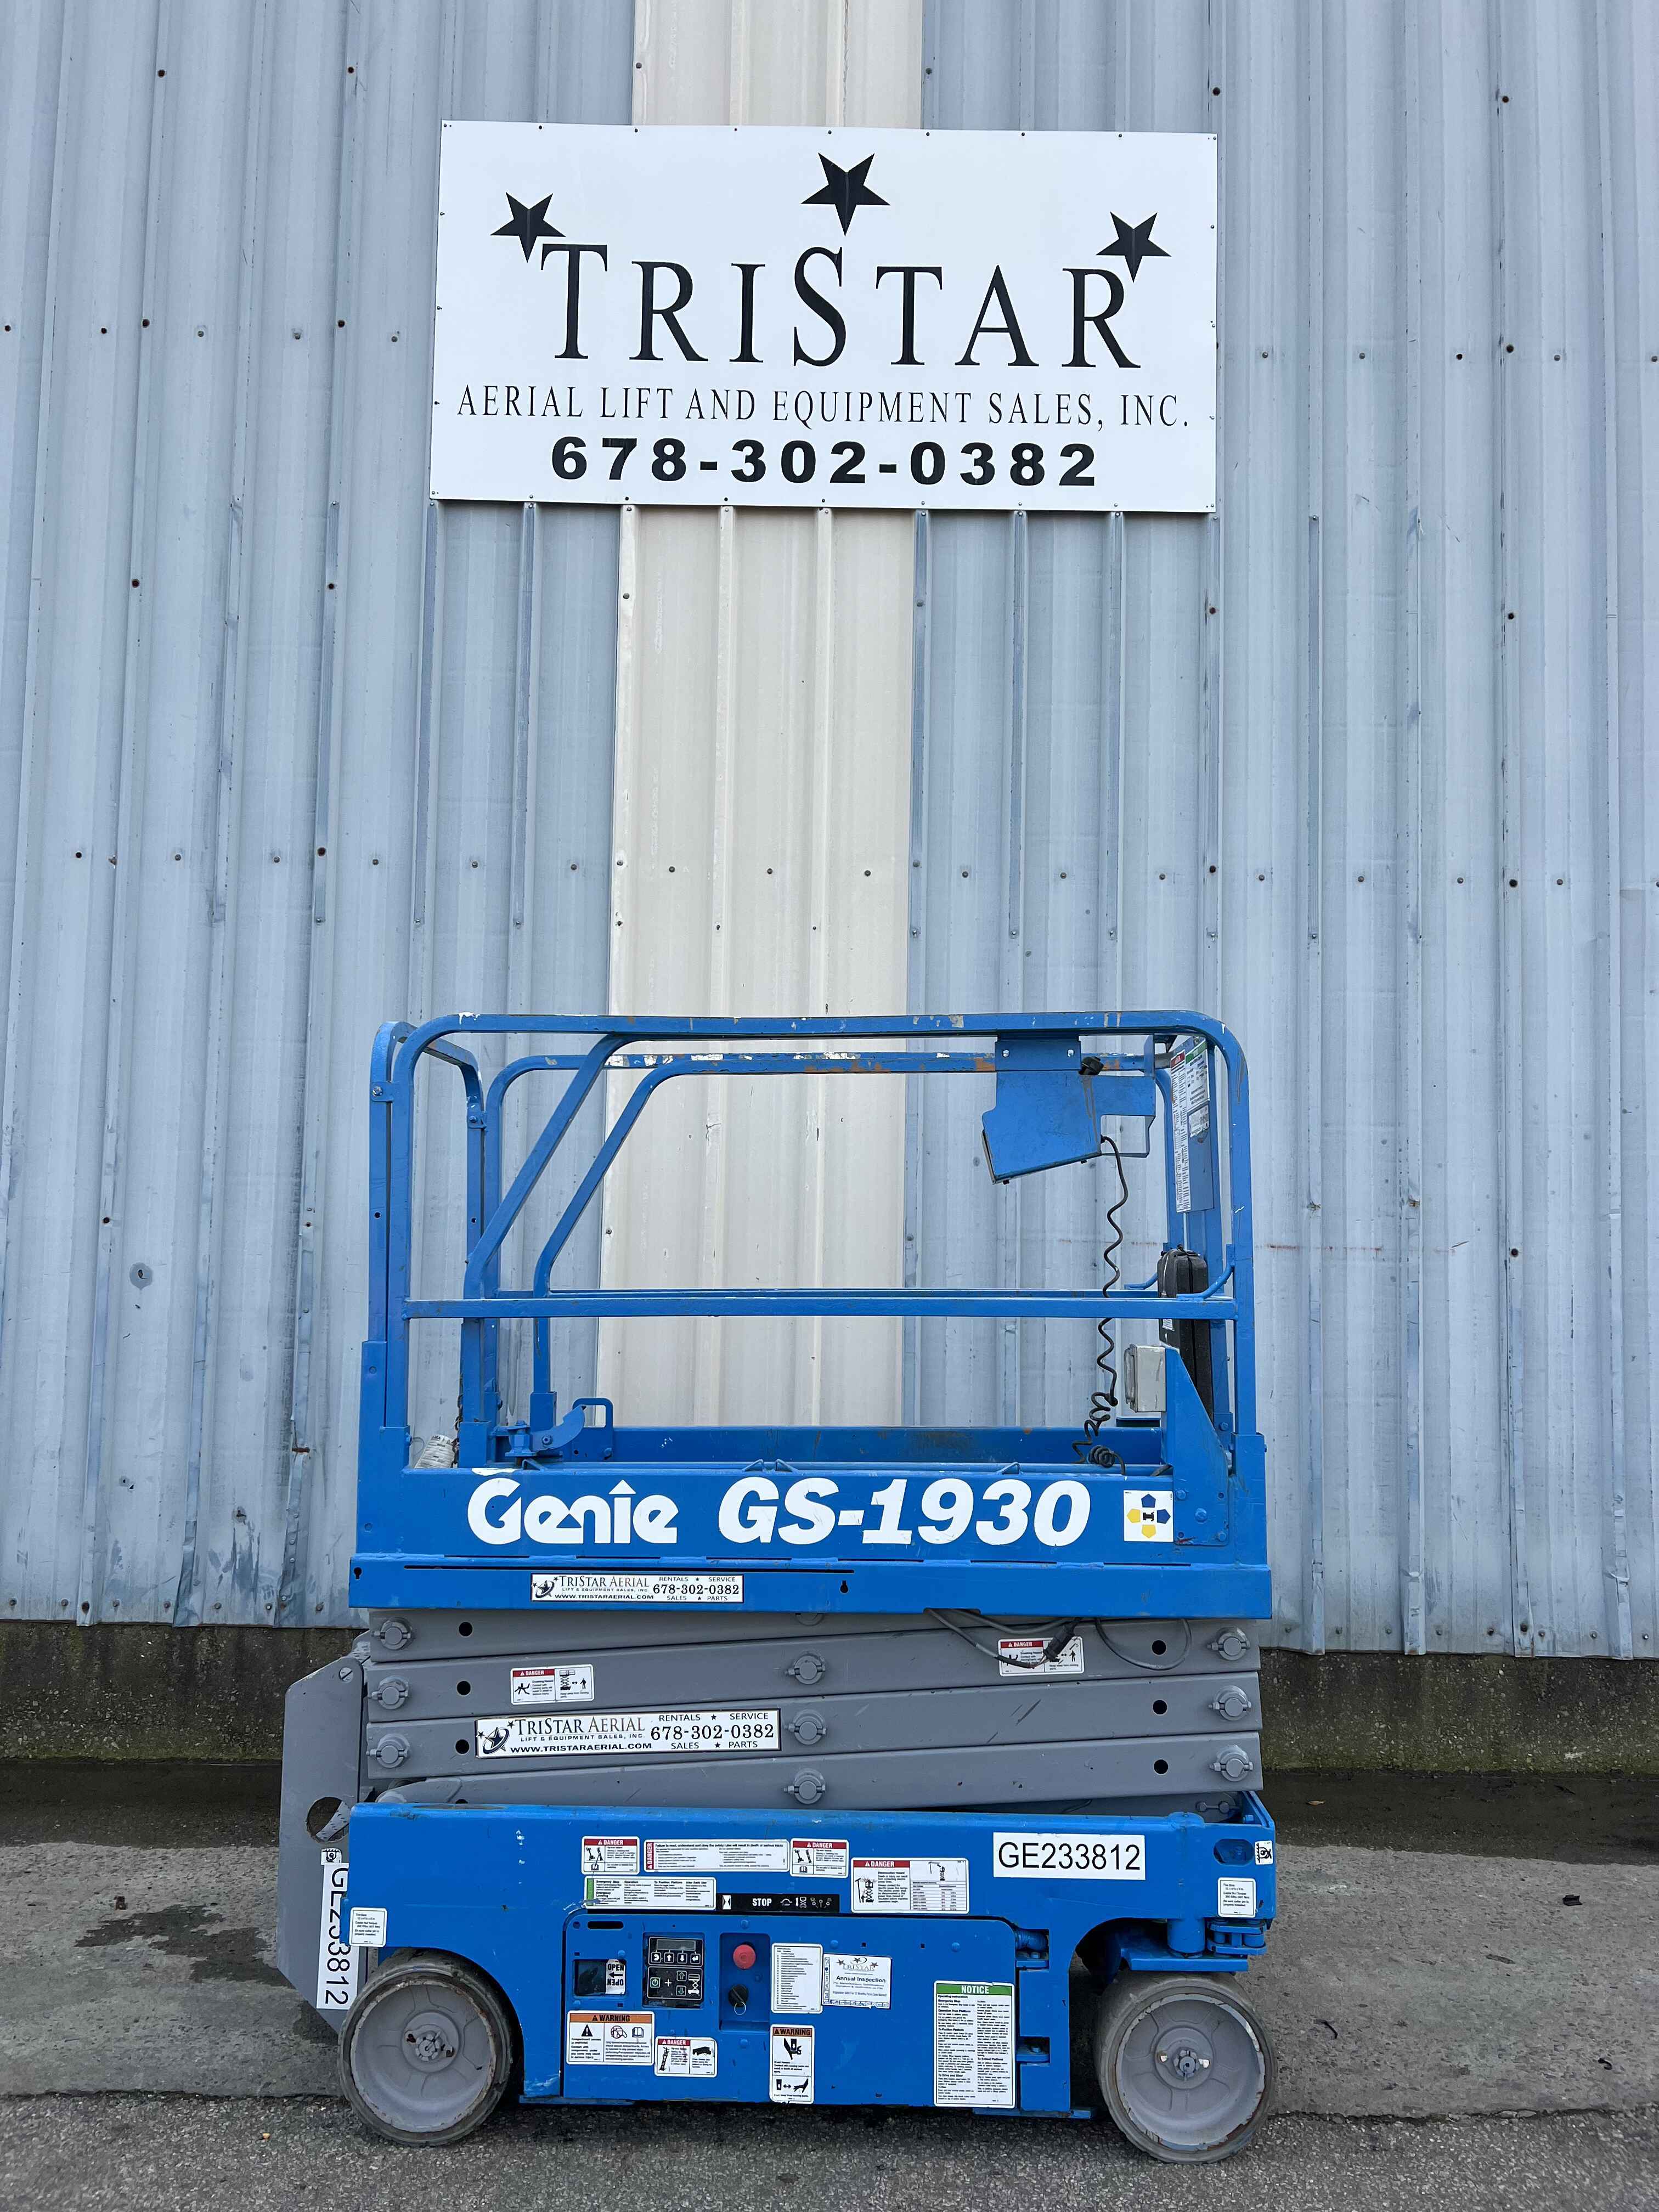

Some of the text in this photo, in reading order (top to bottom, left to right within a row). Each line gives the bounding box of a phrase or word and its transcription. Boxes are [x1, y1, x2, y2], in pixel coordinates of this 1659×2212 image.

[456, 384, 1189, 433] AERIAL LIFT AND EQUIPMENT SALES, INC.
[551, 436, 1097, 487] 678-302-0382
[467, 1476, 1091, 1547] Genie GS-1930
[610, 1576, 649, 1587] AERIAL
[653, 1584, 739, 1594] 678-302-0382
[589, 1716, 645, 1733] AERIAL
[651, 1724, 774, 1740] 678-302-0382
[511, 1743, 652, 1752] WWW.TRISTARAERIAL.COM
[998, 1842, 1141, 1870] GE233812
[752, 1898, 772, 1906] STOP
[961, 1985, 989, 1994] NOTICE
[599, 2014, 630, 2022] WARNING
